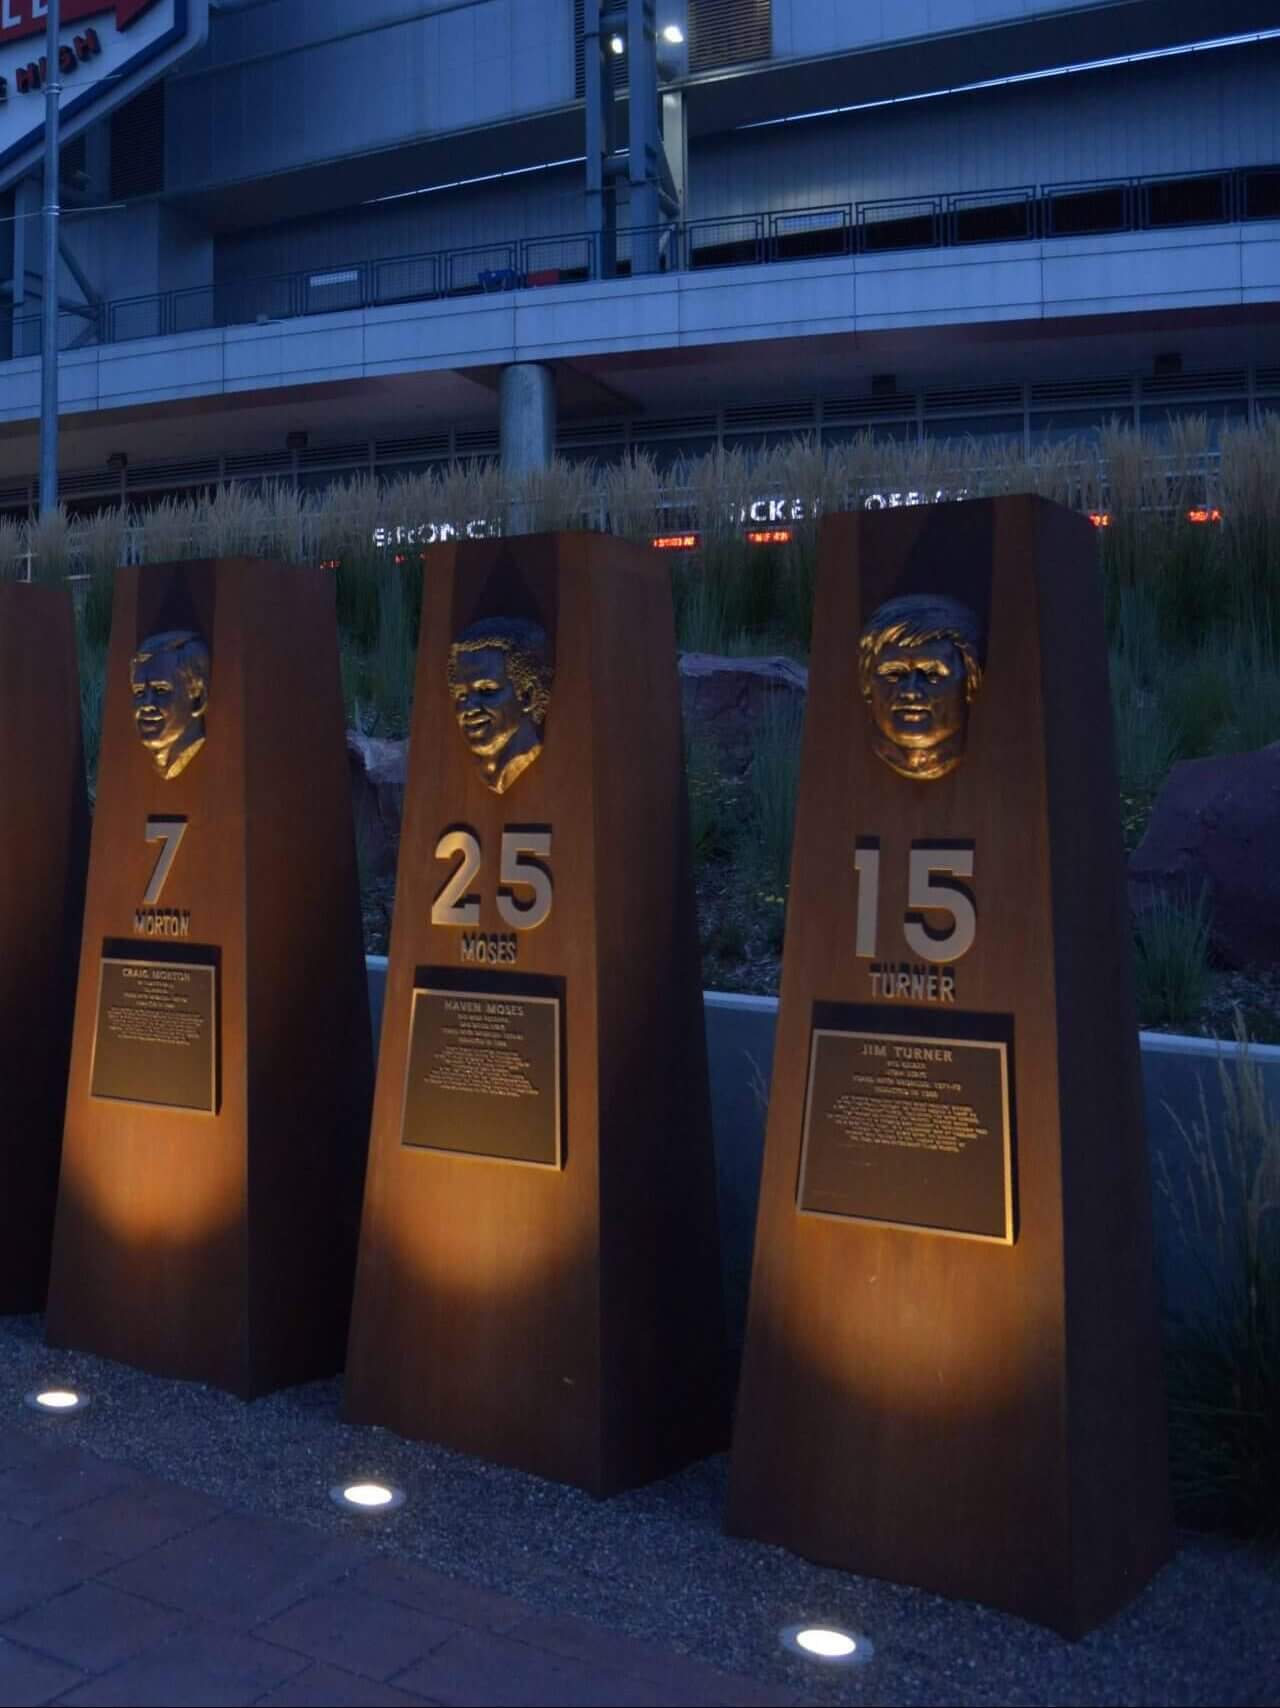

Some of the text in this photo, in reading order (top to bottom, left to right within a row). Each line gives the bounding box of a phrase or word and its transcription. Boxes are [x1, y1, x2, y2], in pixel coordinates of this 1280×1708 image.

[143, 821, 189, 905] 7
[431, 829, 553, 931] 25
[854, 848, 978, 963] 15
[134, 914, 191, 936] MORTON
[461, 939, 518, 964] MOSES
[869, 972, 956, 1003] TURNER
[861, 1043, 953, 1062] JIM TURNER
